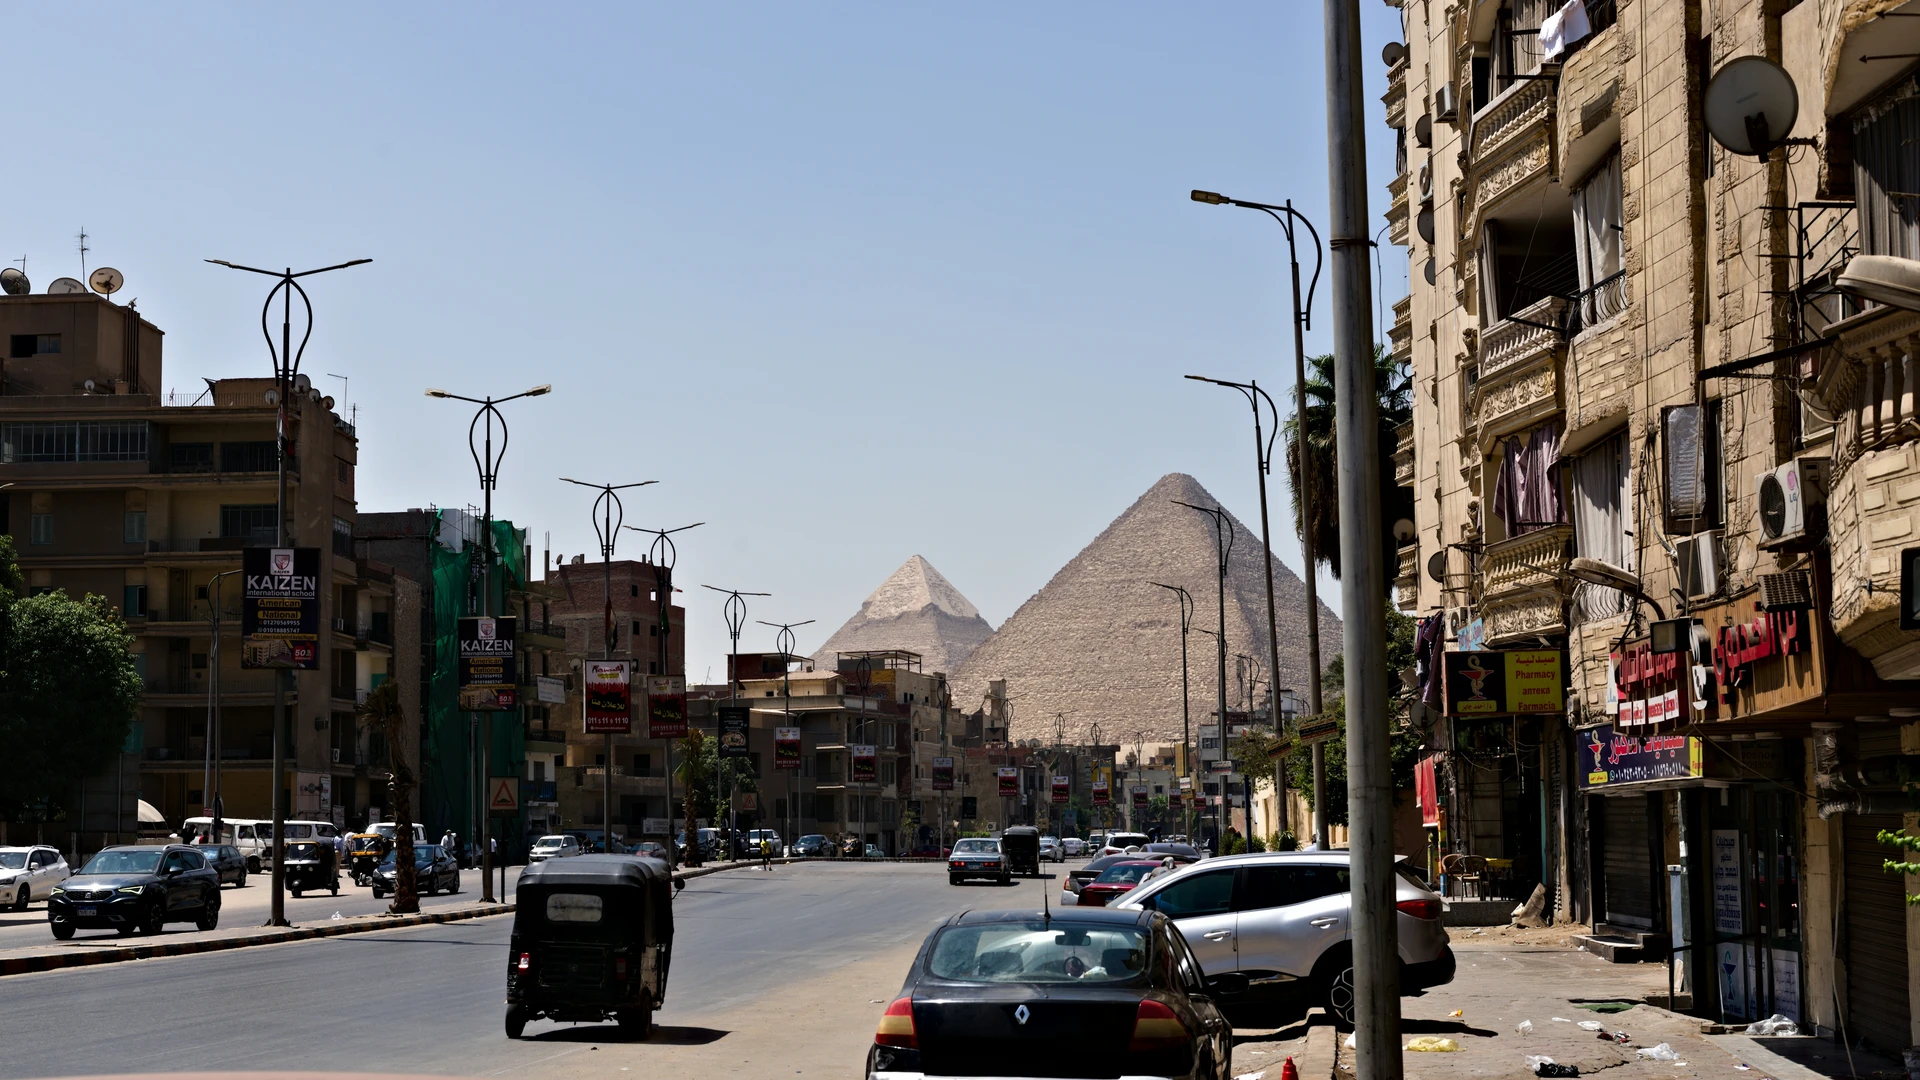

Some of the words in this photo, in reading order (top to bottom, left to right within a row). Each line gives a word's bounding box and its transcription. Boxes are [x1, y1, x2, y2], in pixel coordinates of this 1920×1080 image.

[1789, 493, 1797, 503] LG
[247, 575, 316, 591] KAIZEN
[260, 599, 300, 607] American
[262, 611, 298, 619] National
[460, 640, 513, 652] KAIZEN
[1515, 654, 1555, 666] صيدلية
[1515, 670, 1555, 680] Pharmacy
[1522, 687, 1551, 696] аптека
[591, 698, 601, 706] هنا
[1518, 702, 1556, 711] Farmacia
